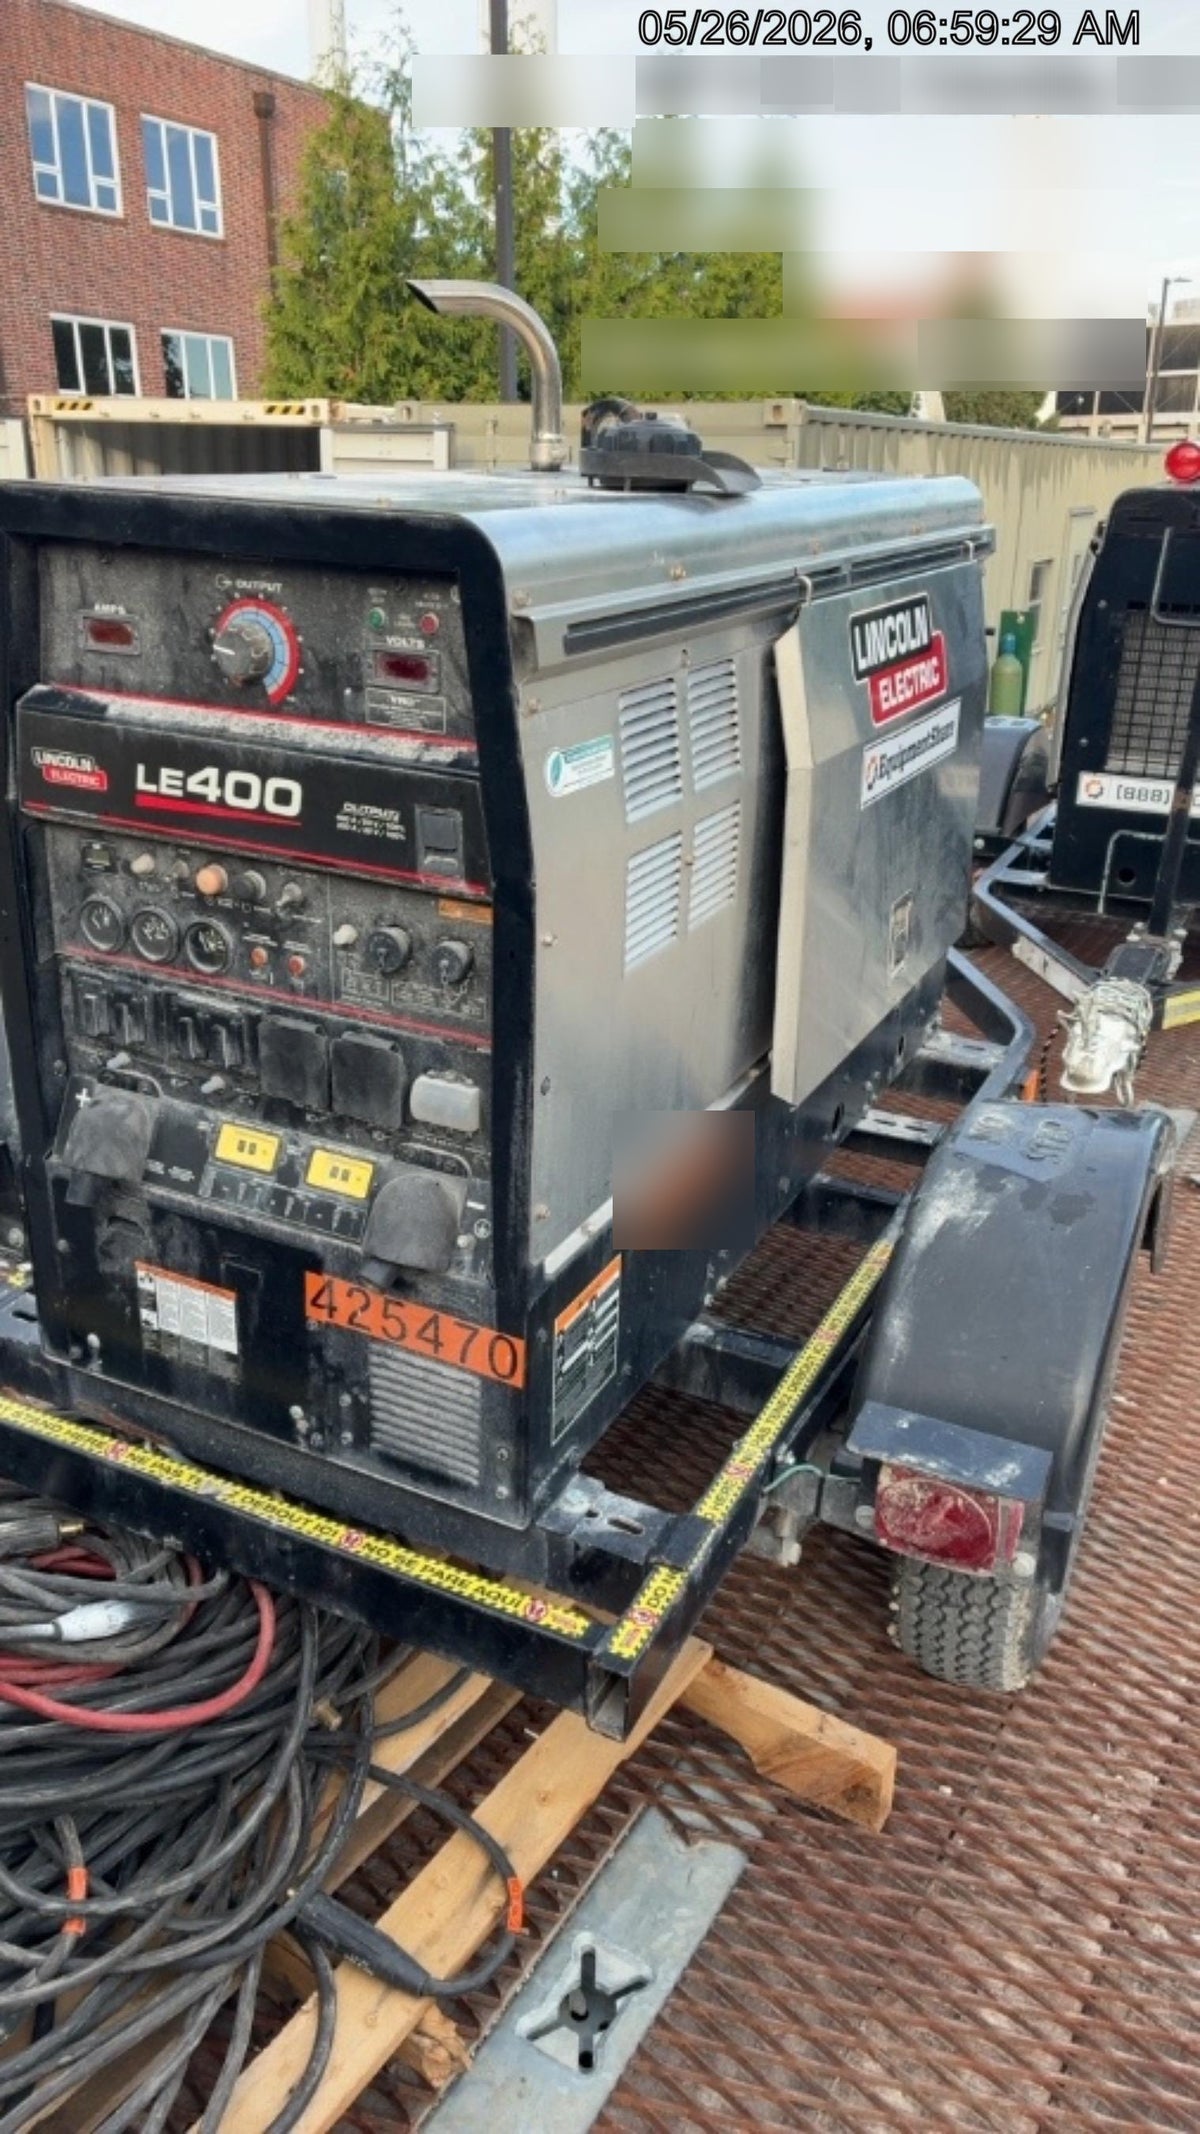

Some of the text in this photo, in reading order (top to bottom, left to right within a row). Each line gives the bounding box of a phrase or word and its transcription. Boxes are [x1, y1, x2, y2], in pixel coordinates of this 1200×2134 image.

[235, 578, 283, 593] OUTPUT
[386, 634, 426, 649] VOLTS
[853, 604, 929, 671] LINCOLN
[878, 656, 940, 712] ELECTRIC
[34, 750, 92, 771] LINCOLN
[136, 763, 302, 817] LE400
[310, 1279, 518, 1382] 425470
[241, 1495, 310, 1526] DEBOUT
[362, 1543, 523, 1609] NO SE PARE AQUI
